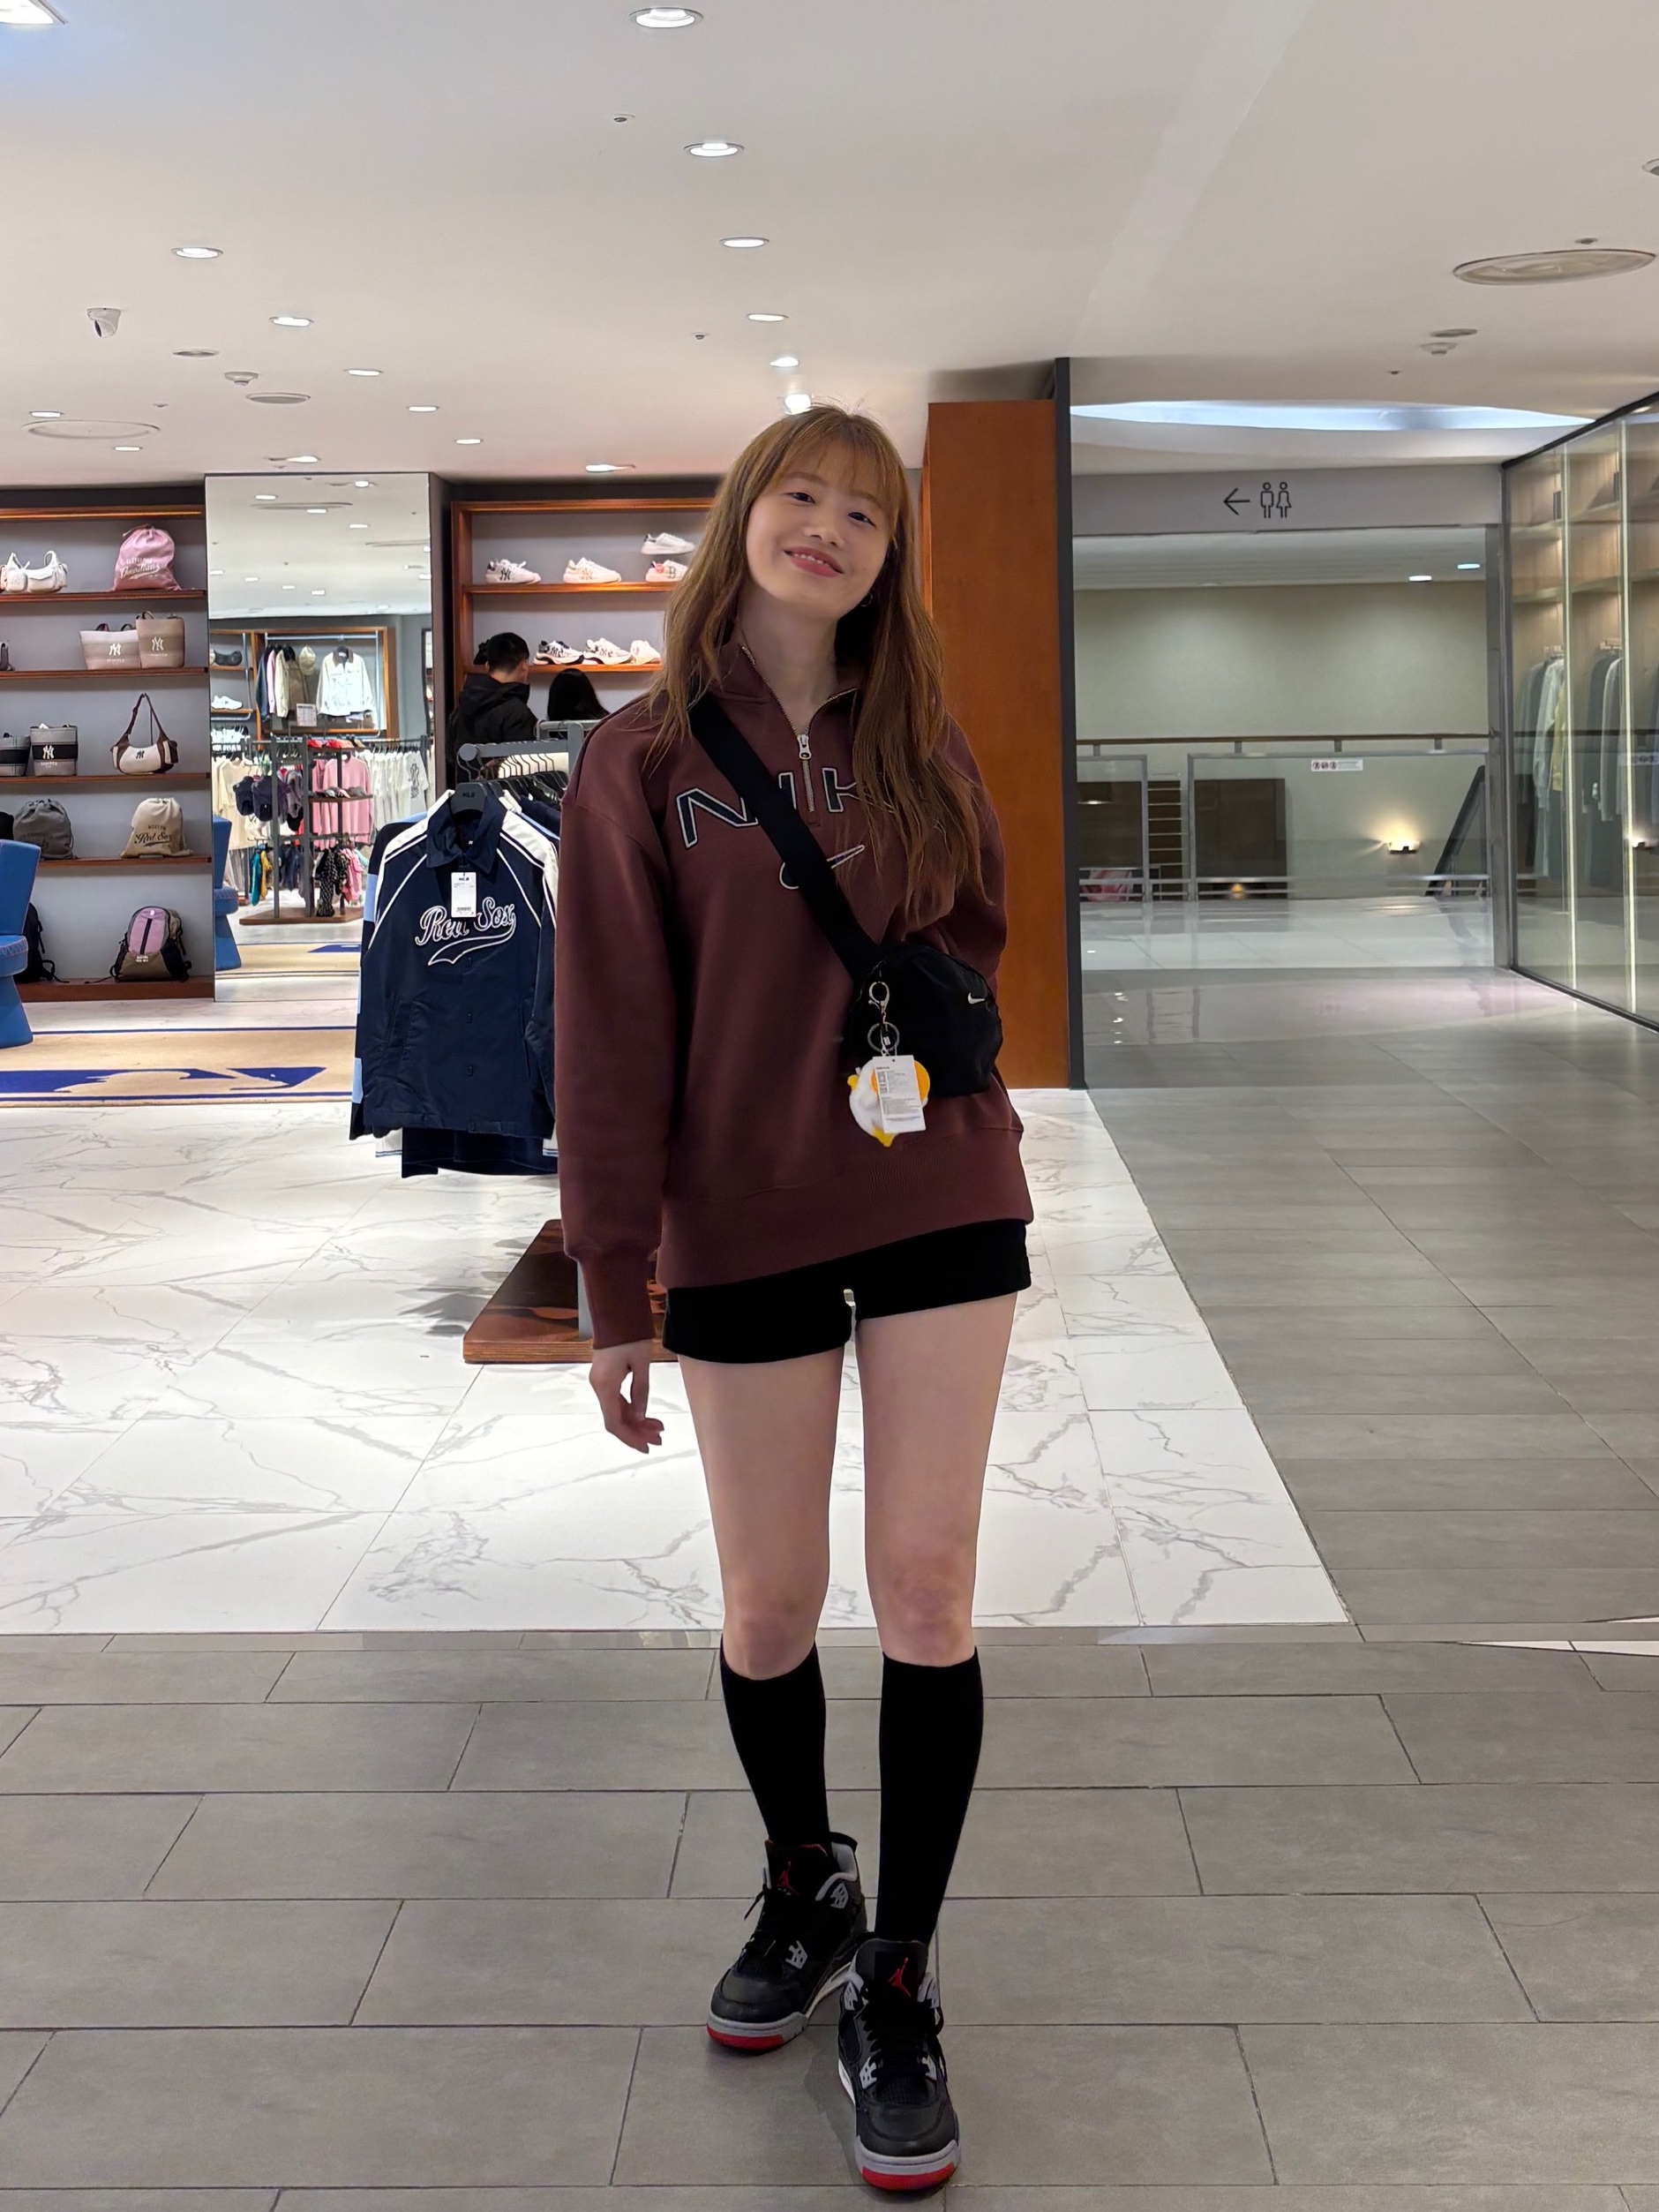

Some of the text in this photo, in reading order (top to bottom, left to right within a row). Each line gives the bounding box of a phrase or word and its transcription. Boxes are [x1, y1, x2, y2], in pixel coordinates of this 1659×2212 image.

[152, 636, 164, 651] NY
[42, 745, 55, 760] NY
[474, 896, 515, 932] Sox
